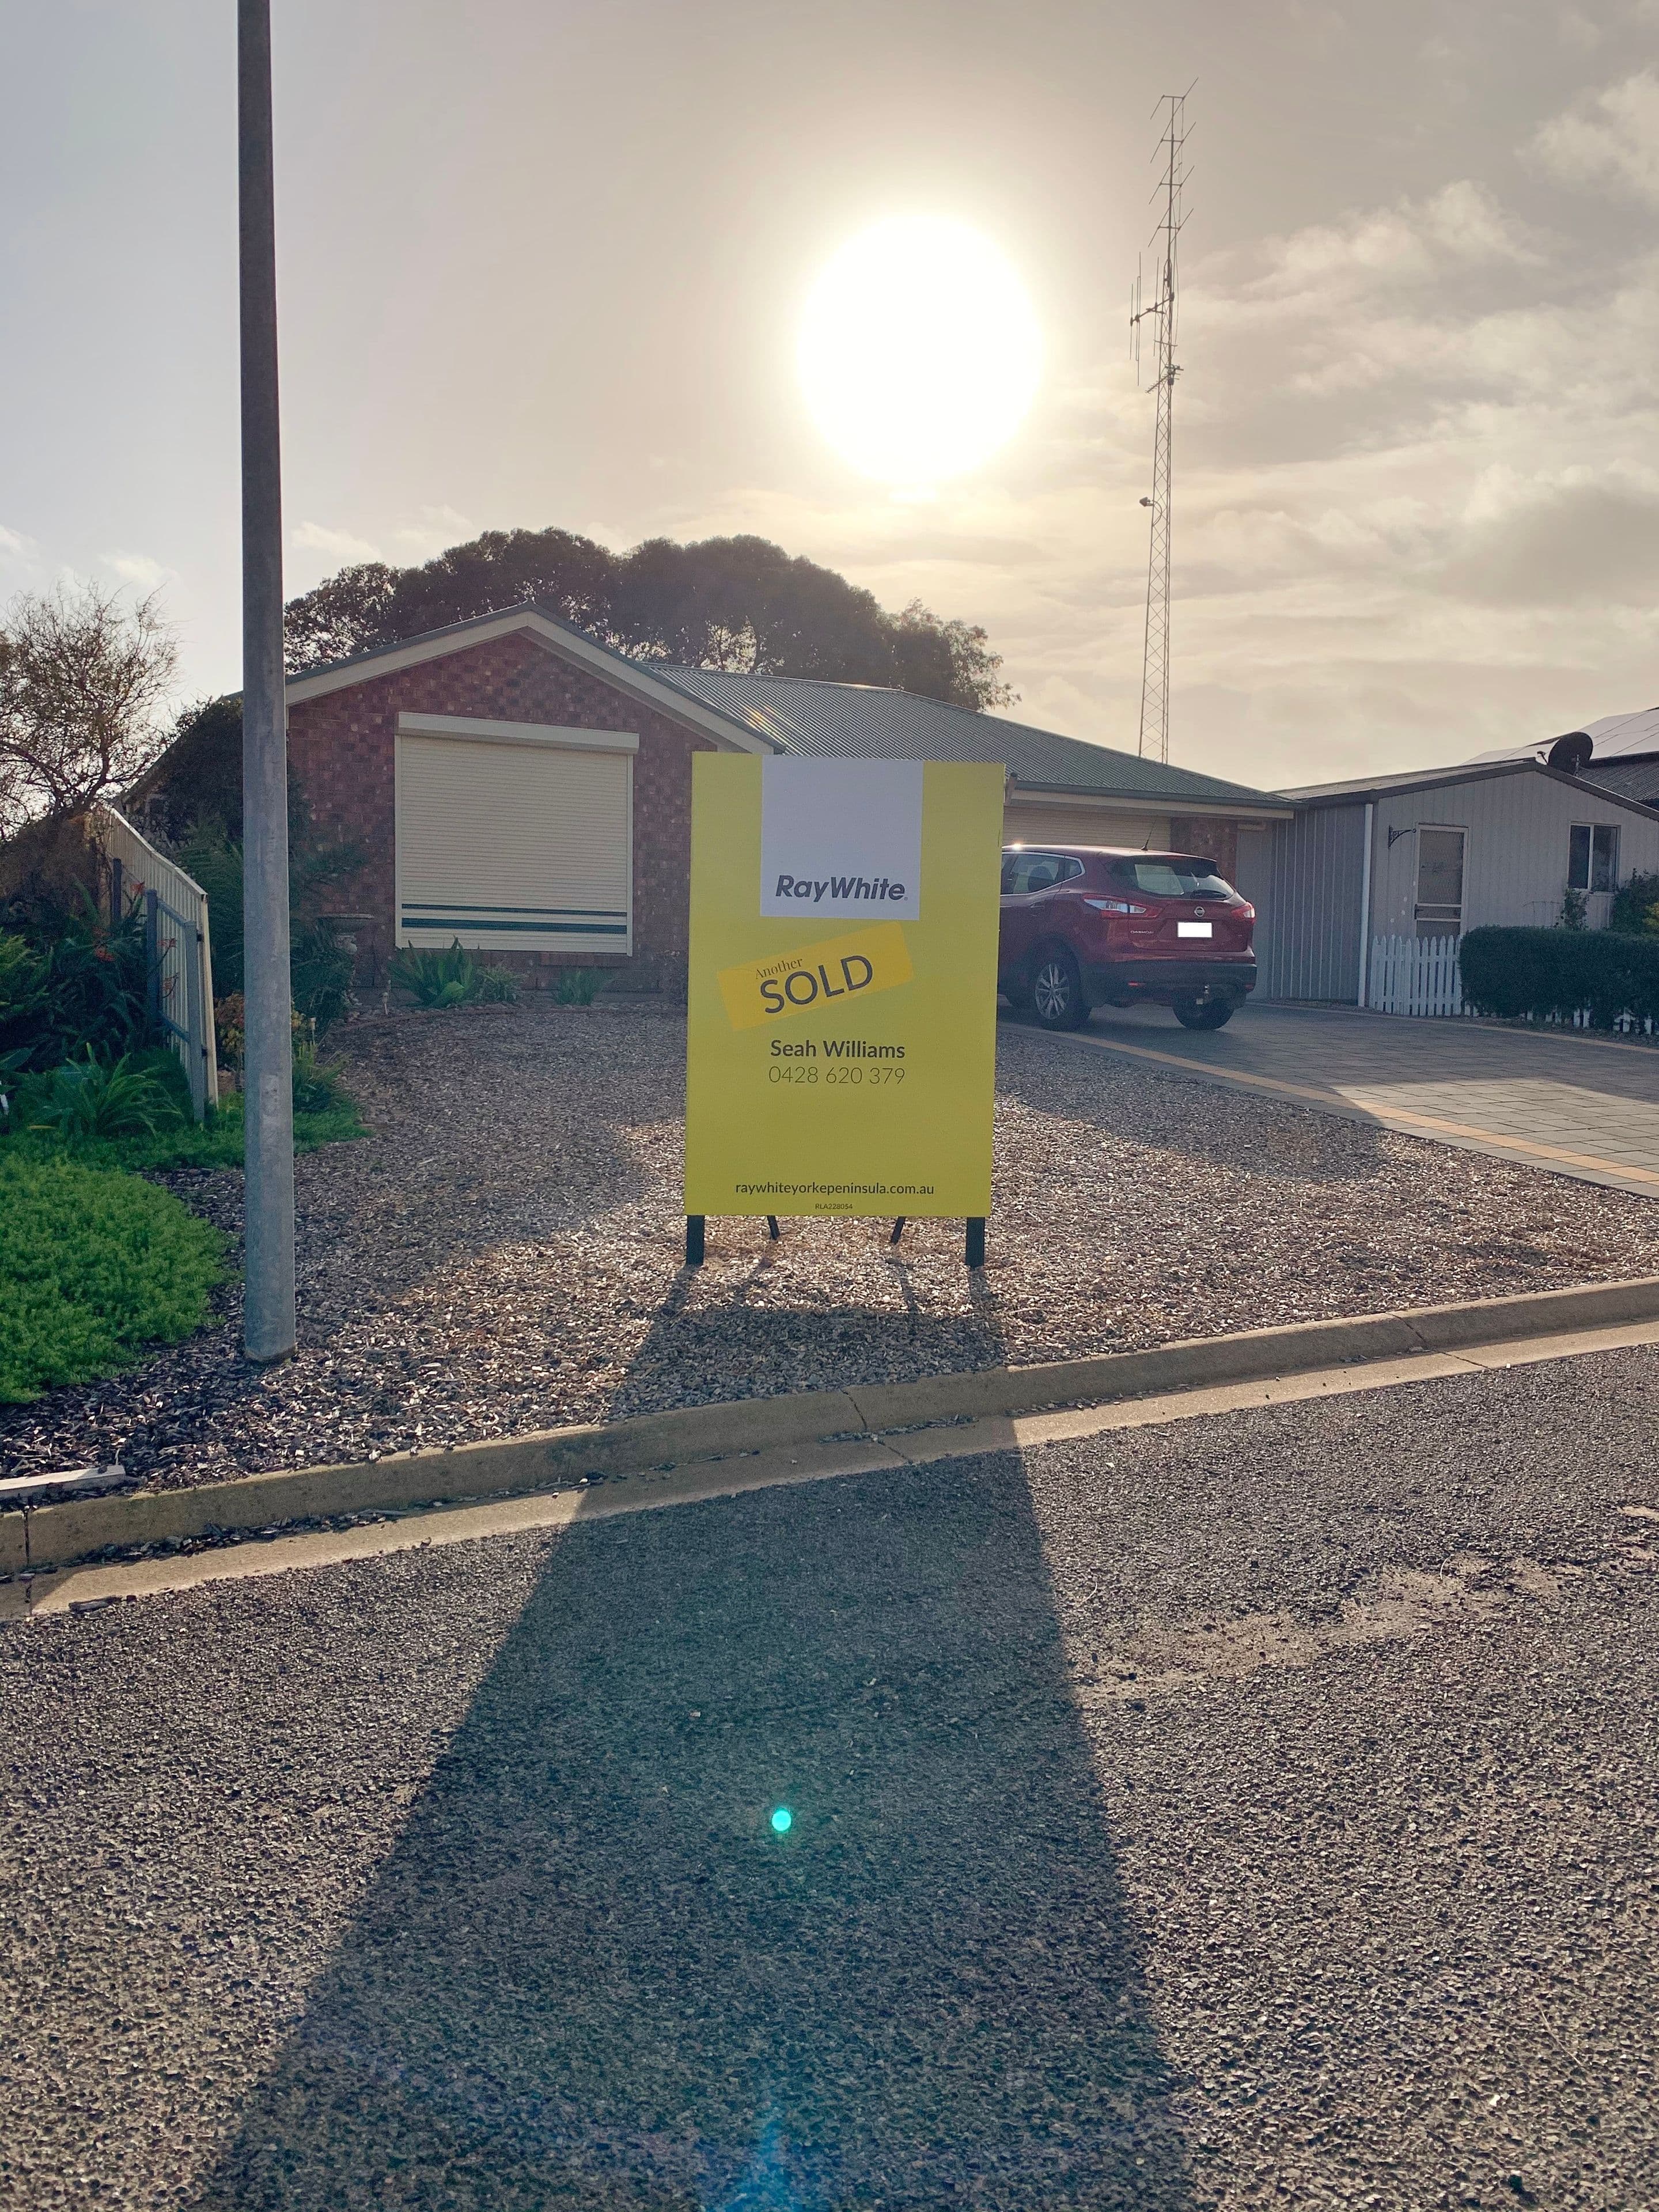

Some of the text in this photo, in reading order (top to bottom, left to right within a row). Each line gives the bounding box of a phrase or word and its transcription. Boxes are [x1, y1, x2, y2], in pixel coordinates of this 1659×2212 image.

[756, 958, 803, 979] Another
[760, 955, 873, 1013] SOLD
[770, 1040, 905, 1058] Seah Williams
[769, 1066, 905, 1084] 0428 620 379
[736, 1182, 934, 1195] raywhiteyorkepeninsula.com.au
